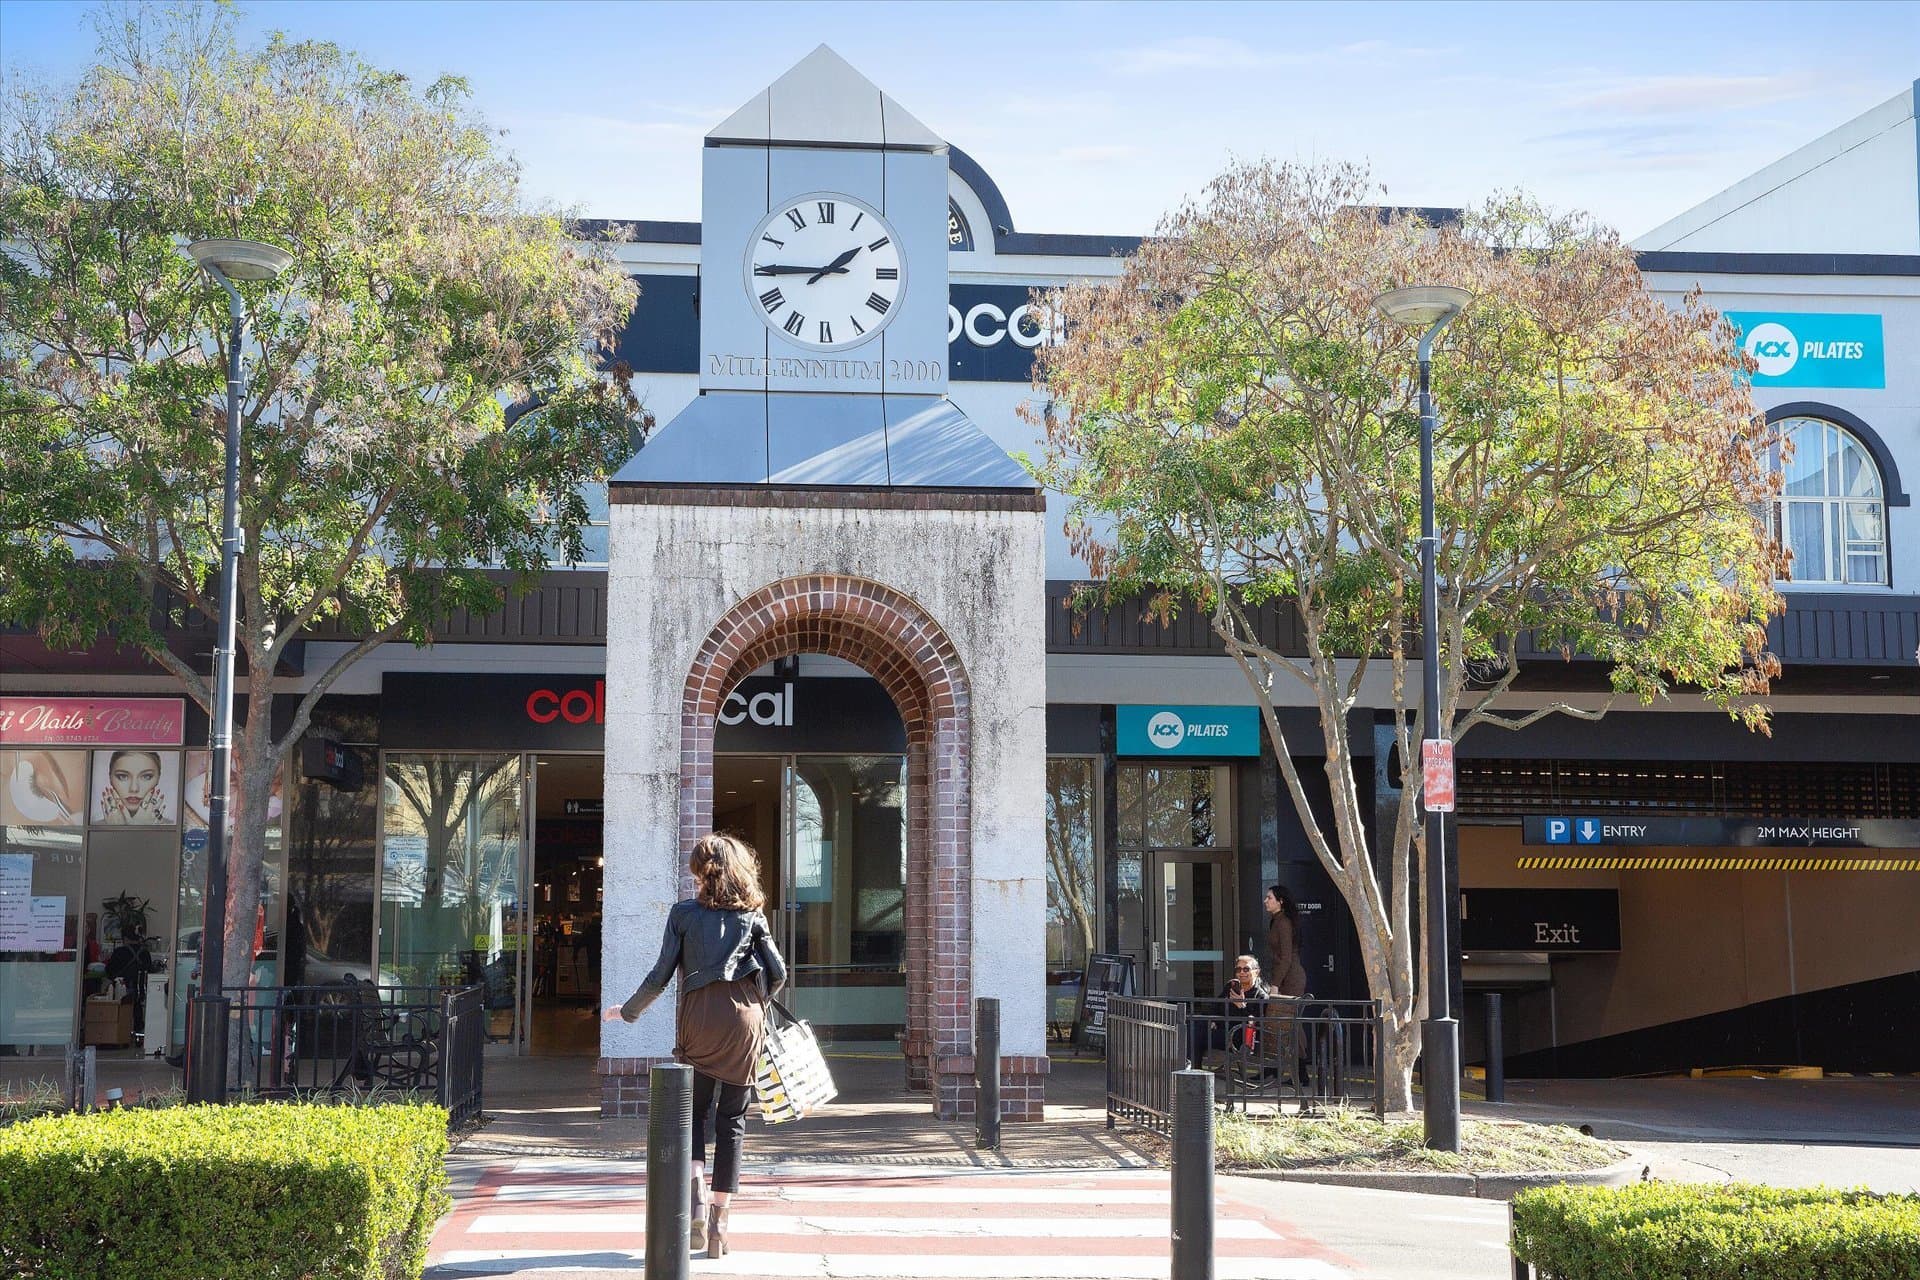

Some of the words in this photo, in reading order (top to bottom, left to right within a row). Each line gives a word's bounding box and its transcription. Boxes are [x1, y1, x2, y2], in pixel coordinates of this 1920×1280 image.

[785, 208, 807, 232] XI
[817, 202, 834, 224] XII
[868, 236, 890, 252] II
[876, 268, 897, 280] III
[759, 287, 786, 314] VIII
[783, 310, 805, 336] VII
[820, 321, 833, 343] VI
[1803, 341, 1864, 360] PILATES
[708, 354, 881, 380] MILLENNIUM
[890, 359, 942, 382] 2000
[19, 705, 85, 732] Nails
[96, 708, 174, 739] Beauty
[1187, 724, 1229, 737] PILATES
[1432, 744, 1443, 755] NO
[1551, 822, 1565, 840] P
[1603, 825, 1647, 837] ENTRY
[1757, 826, 1775, 839] 2M
[1779, 827, 1809, 839] MAX
[1812, 827, 1861, 840] HEIGHT
[1534, 922, 1580, 944] Exit
